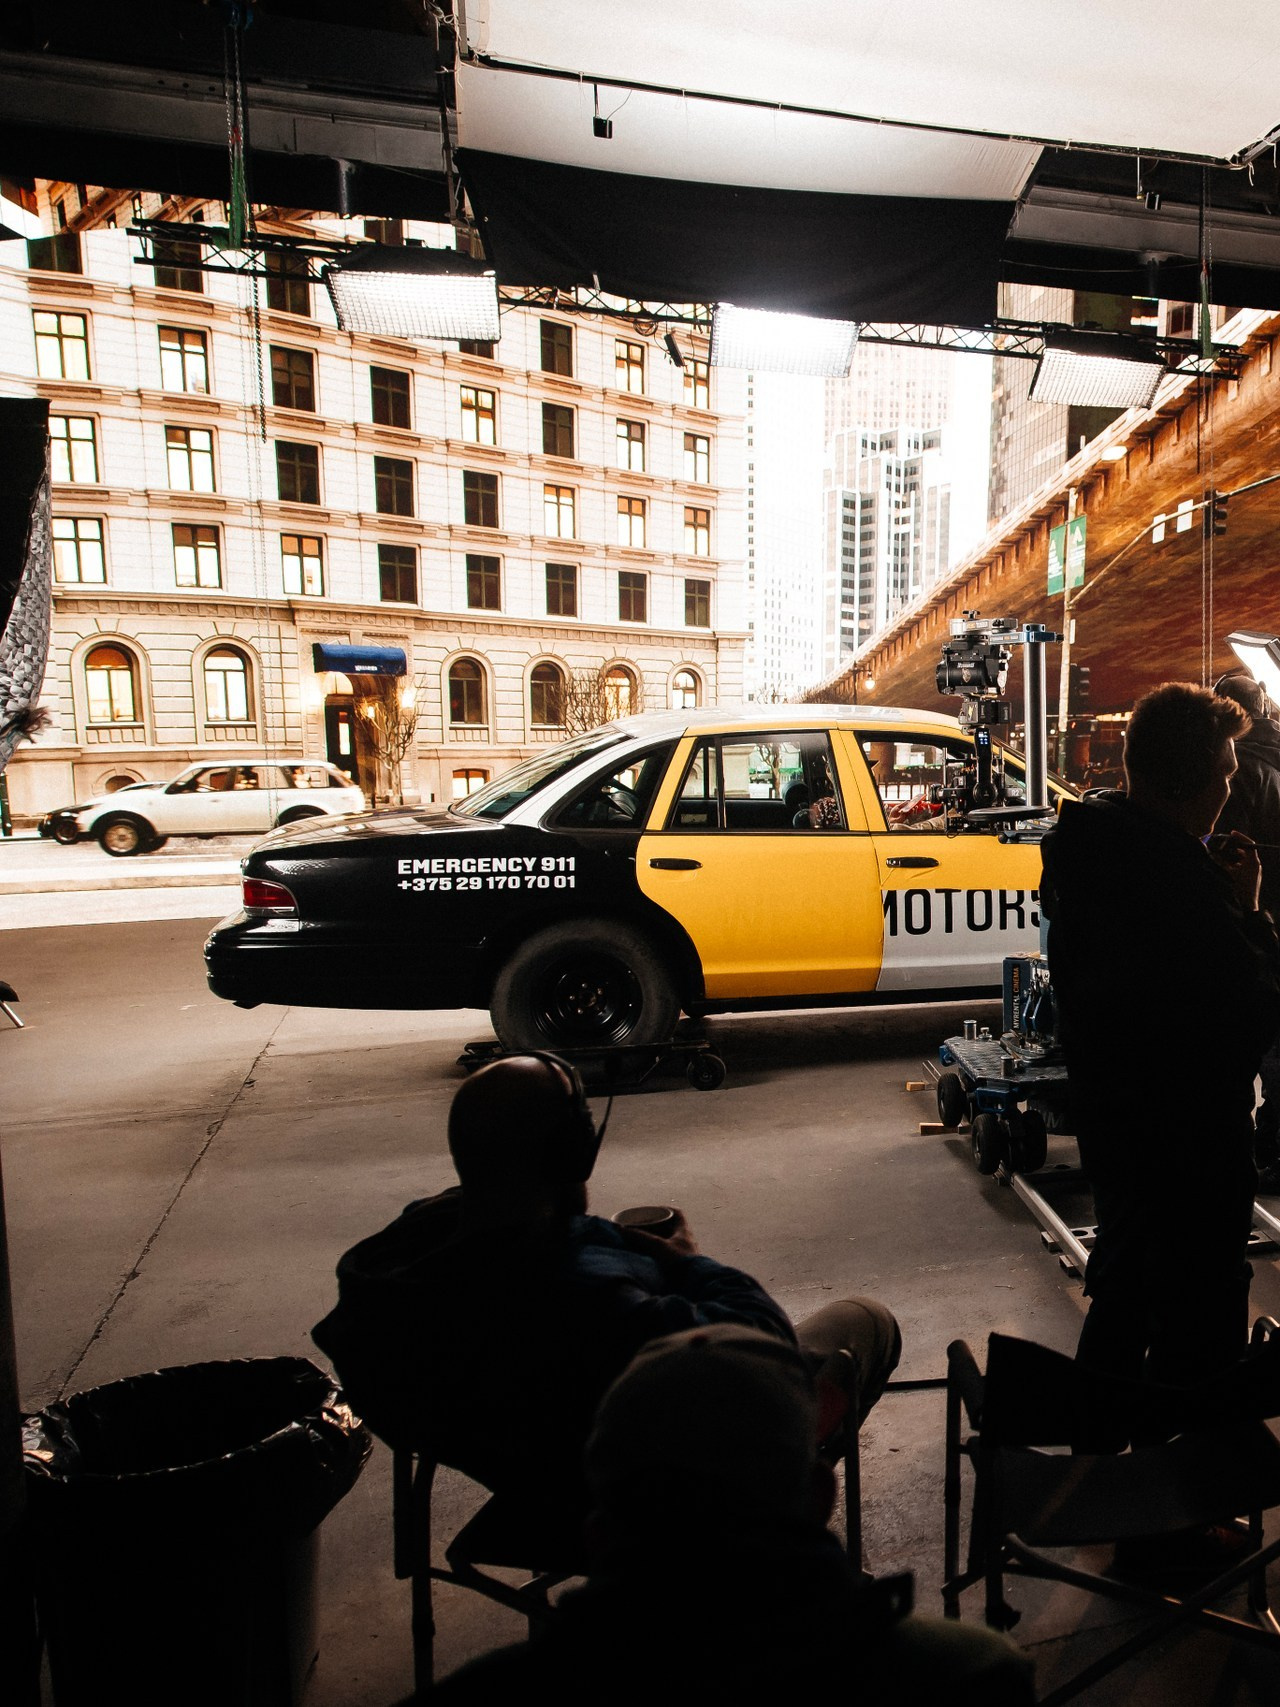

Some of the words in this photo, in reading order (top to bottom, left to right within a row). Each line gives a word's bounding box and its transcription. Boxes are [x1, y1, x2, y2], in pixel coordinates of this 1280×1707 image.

[397, 857, 537, 874] EMERGENCY
[541, 856, 576, 872] 911
[397, 877, 452, 892] +375
[455, 876, 483, 891] 29
[485, 876, 521, 890] 170
[524, 876, 550, 889] 70
[553, 875, 576, 889] 01
[1012, 967, 1020, 993] CINEMA
